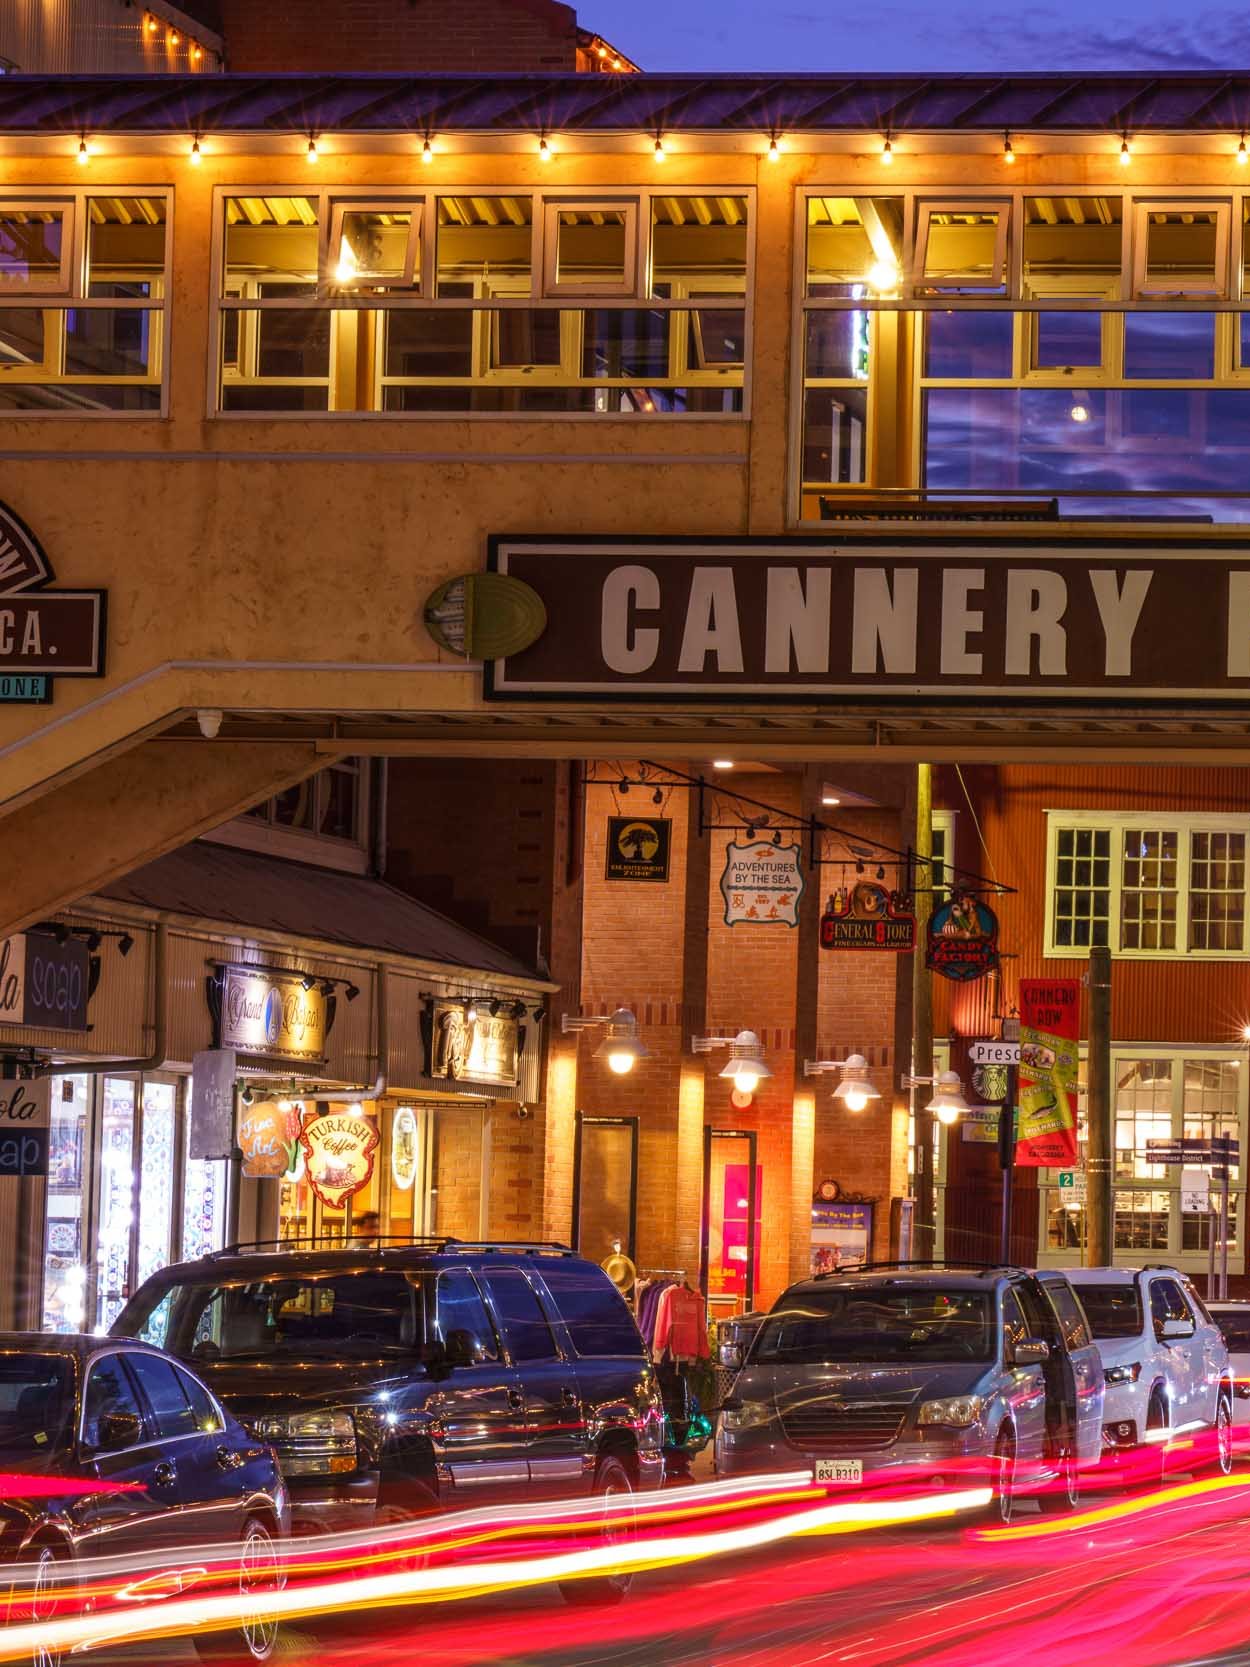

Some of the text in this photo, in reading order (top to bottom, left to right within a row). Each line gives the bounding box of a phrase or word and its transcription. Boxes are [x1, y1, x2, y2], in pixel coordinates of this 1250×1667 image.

[600, 564, 1154, 676] CANNERY
[731, 862, 796, 873] ADVENTURES
[735, 873, 792, 885] BY THE SEA
[824, 922, 913, 943] GENERAL STORE
[32, 957, 81, 1028] soap
[308, 1118, 370, 1143] TURKISH
[322, 1137, 358, 1156] Coffee
[1148, 1154, 1203, 1163] Lighthouse District
[1063, 1174, 1071, 1186] 2
